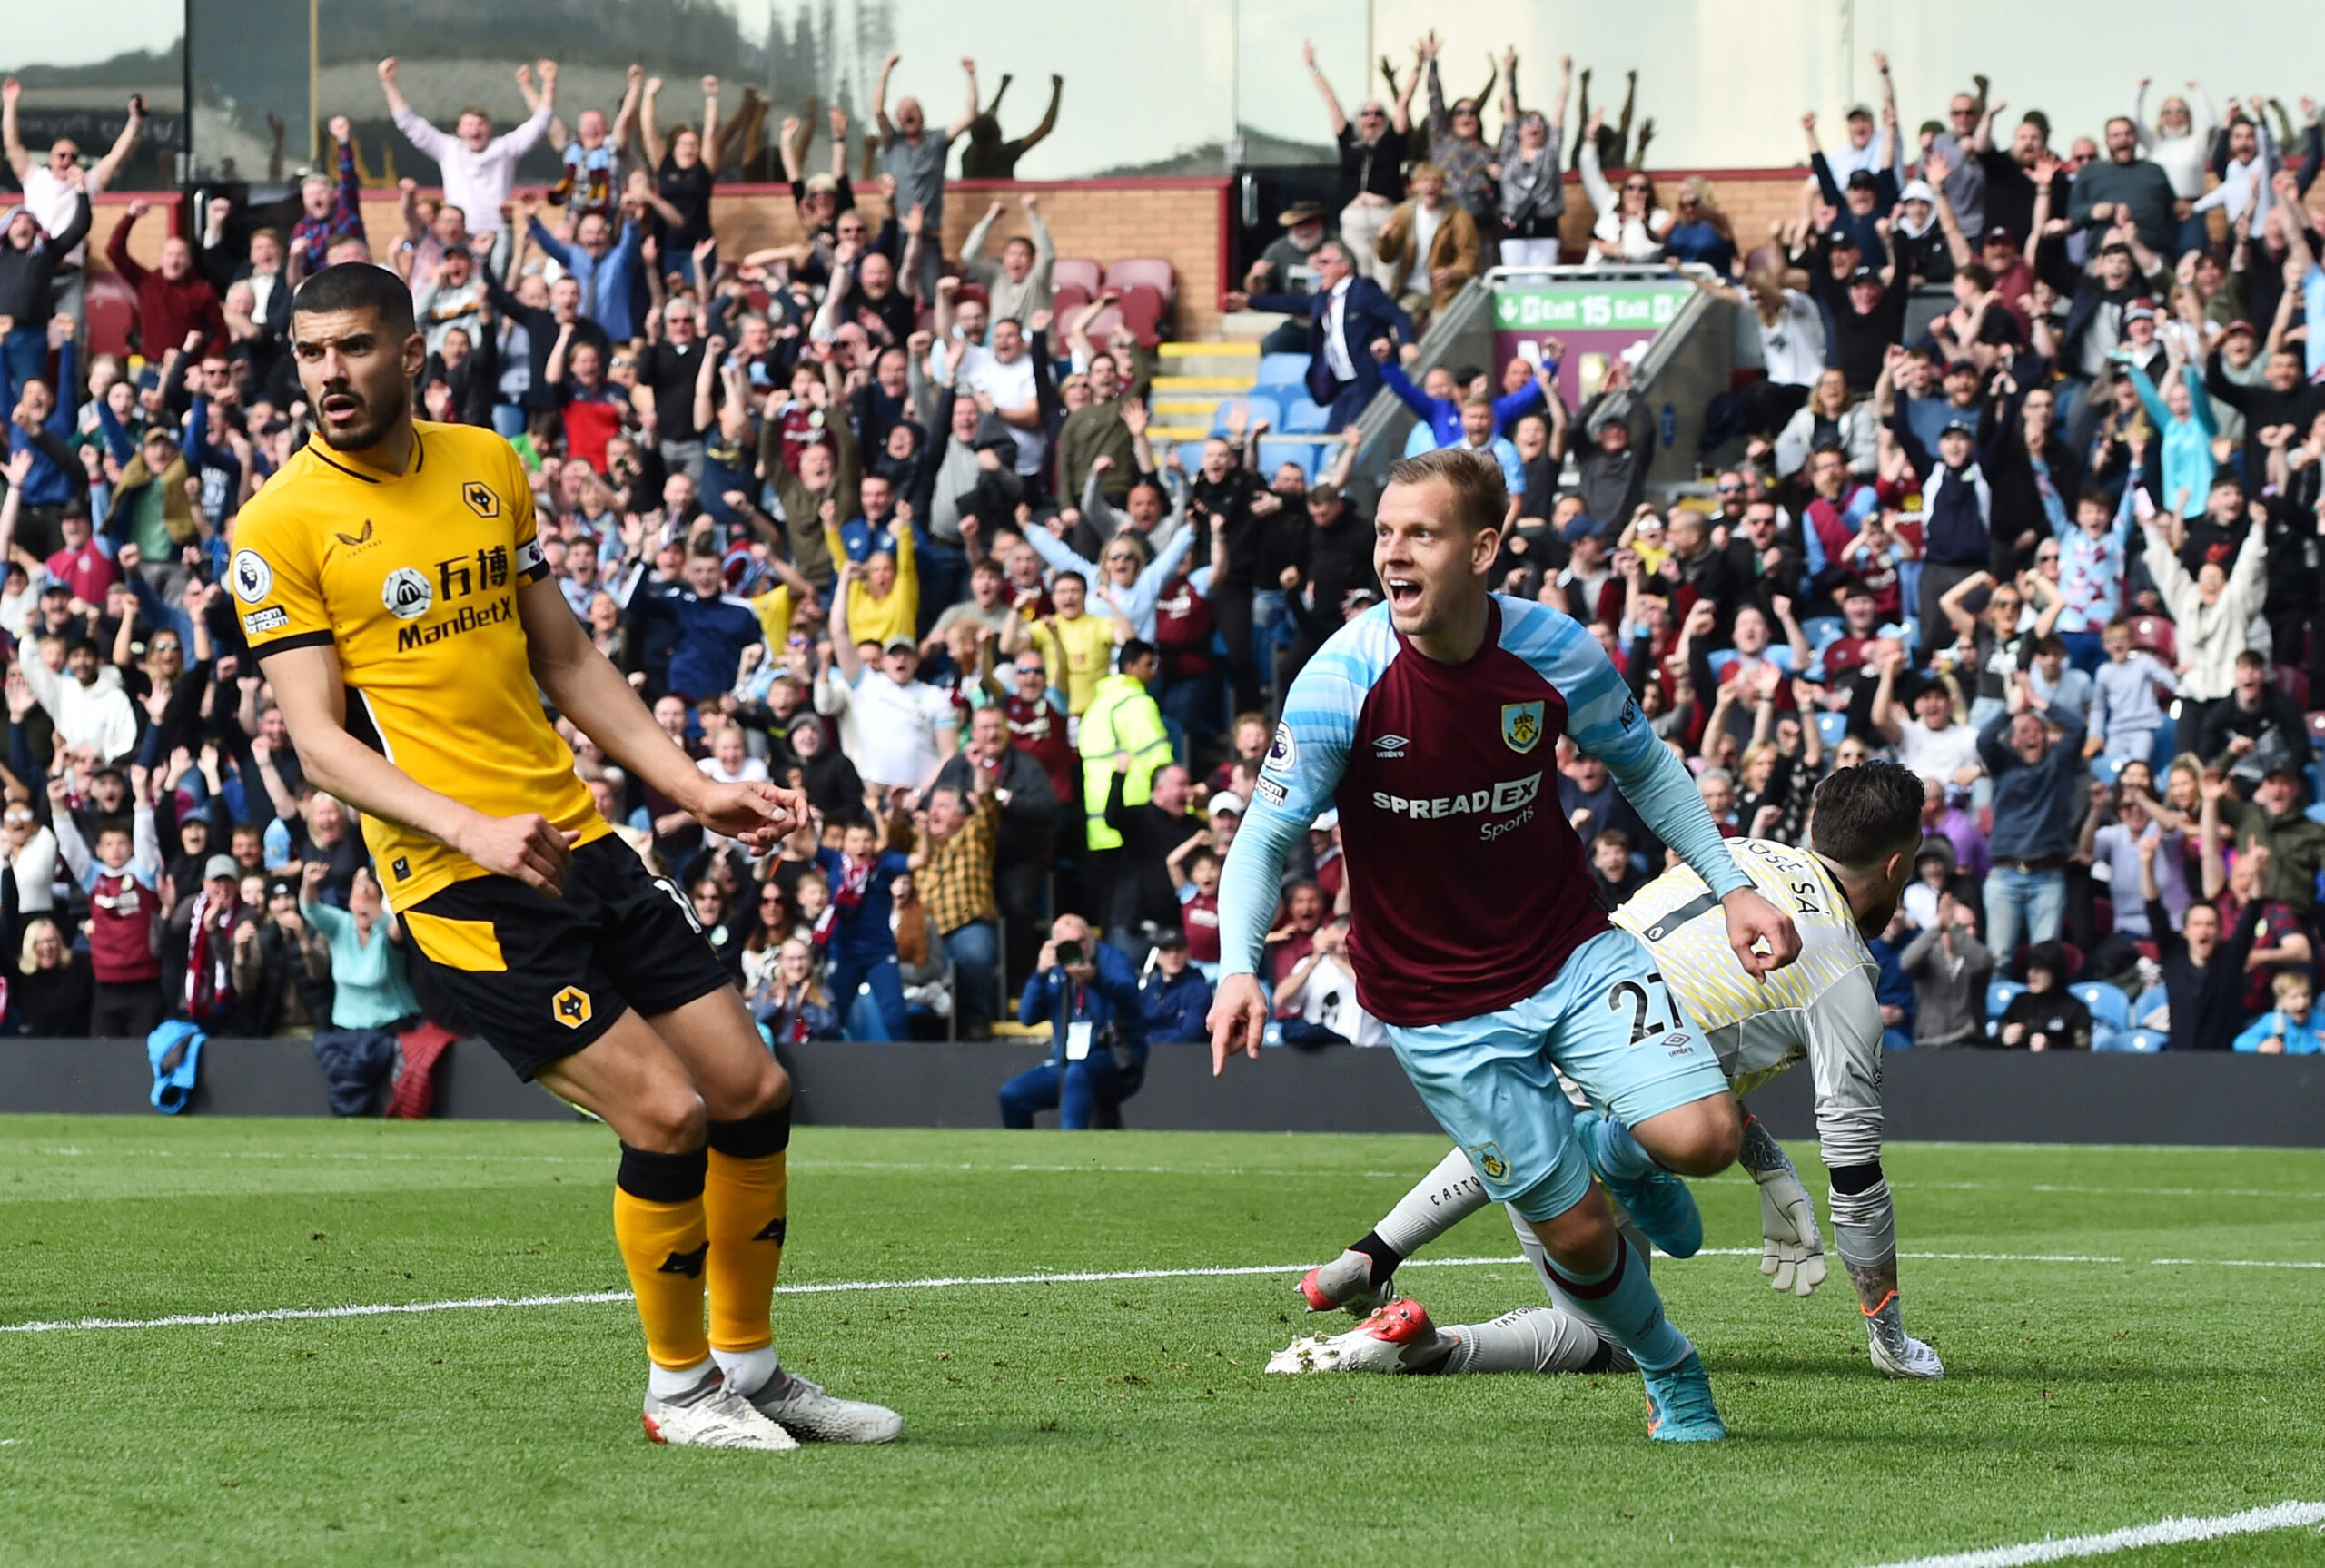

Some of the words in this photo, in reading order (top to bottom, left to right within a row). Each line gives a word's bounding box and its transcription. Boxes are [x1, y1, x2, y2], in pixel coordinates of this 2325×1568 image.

[1542, 299, 1577, 320] Exit
[1579, 294, 1612, 325] 15
[1614, 299, 1650, 320] Exit
[435, 545, 509, 602] 万博
[398, 596, 513, 653] ManBetX
[1479, 805, 1535, 841] Sports
[1608, 971, 1684, 1046] 27
[1667, 1046, 1694, 1058] umbro
